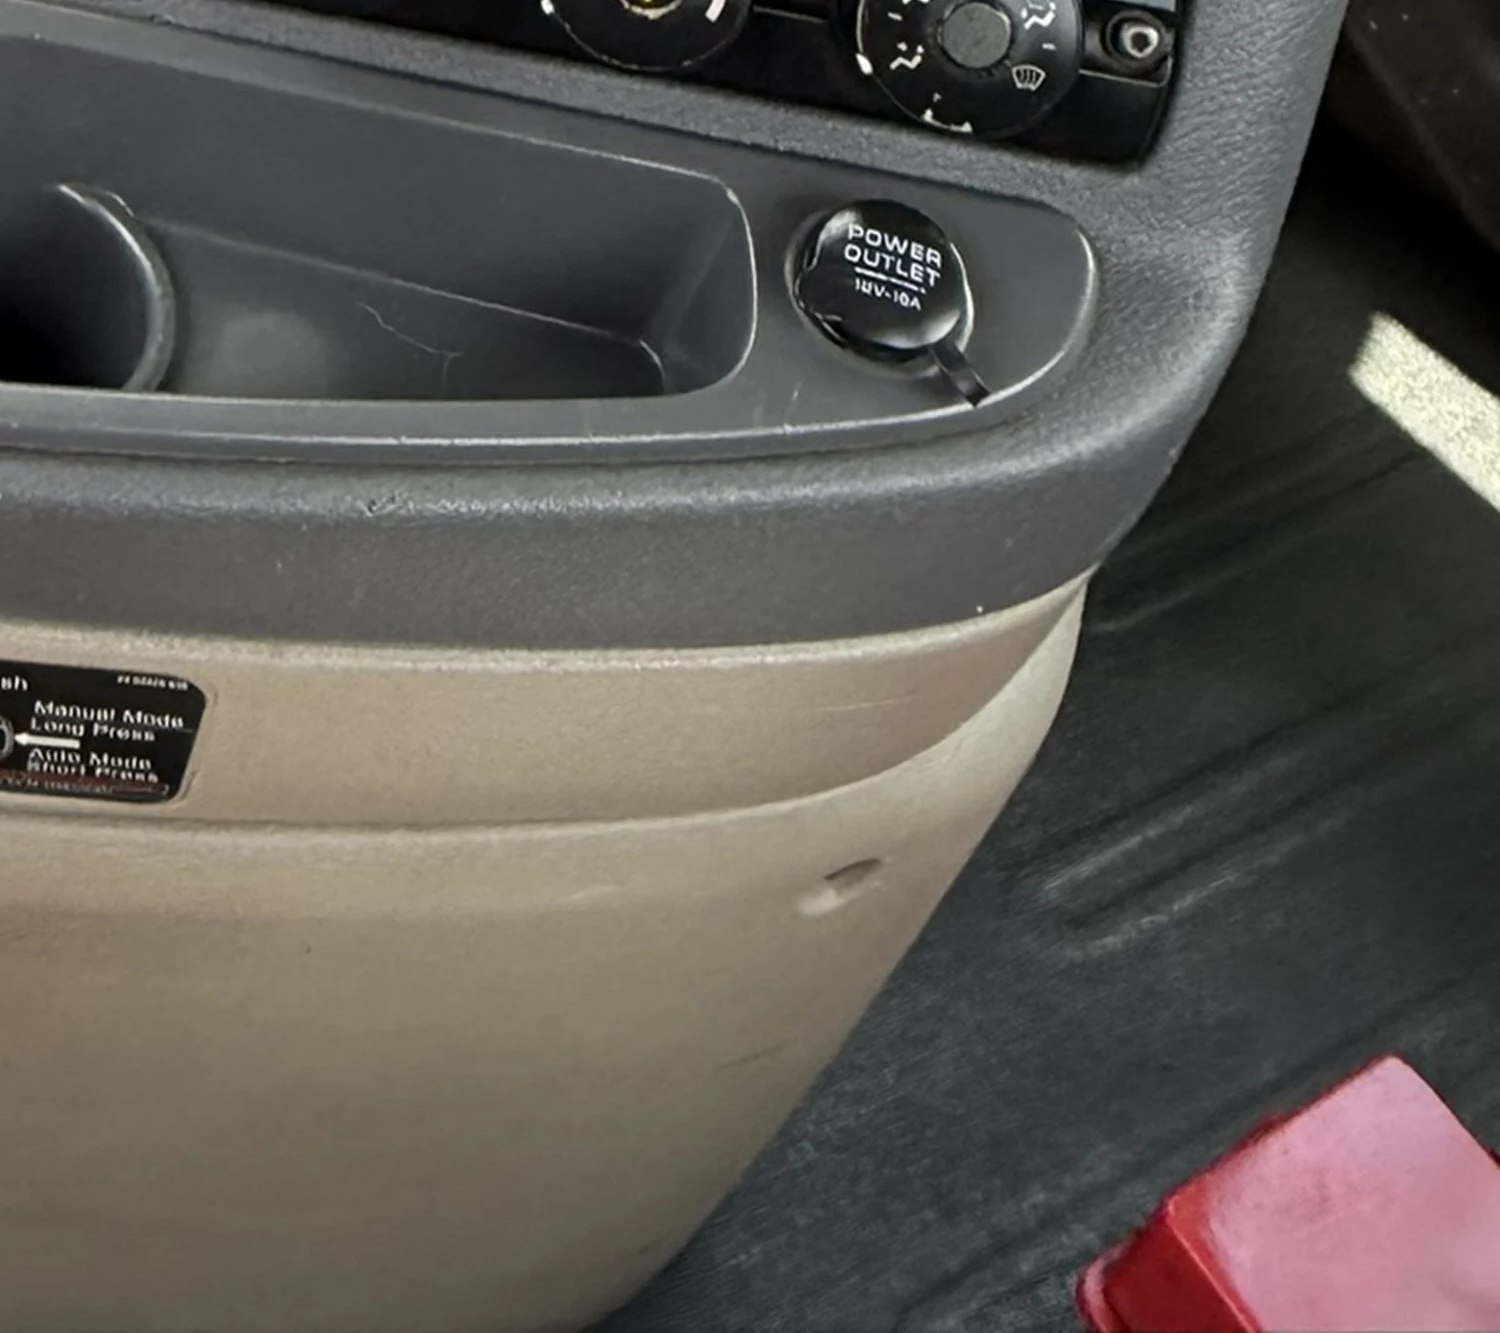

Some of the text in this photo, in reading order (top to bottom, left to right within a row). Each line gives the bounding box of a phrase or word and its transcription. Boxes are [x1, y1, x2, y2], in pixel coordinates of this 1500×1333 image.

[847, 224, 942, 268] POWER
[844, 244, 941, 287] OUTLET
[34, 700, 184, 729] Manual Mode
[30, 717, 156, 742] Long Press
[26, 759, 86, 776] Short
[28, 747, 152, 770] Auto Mode
